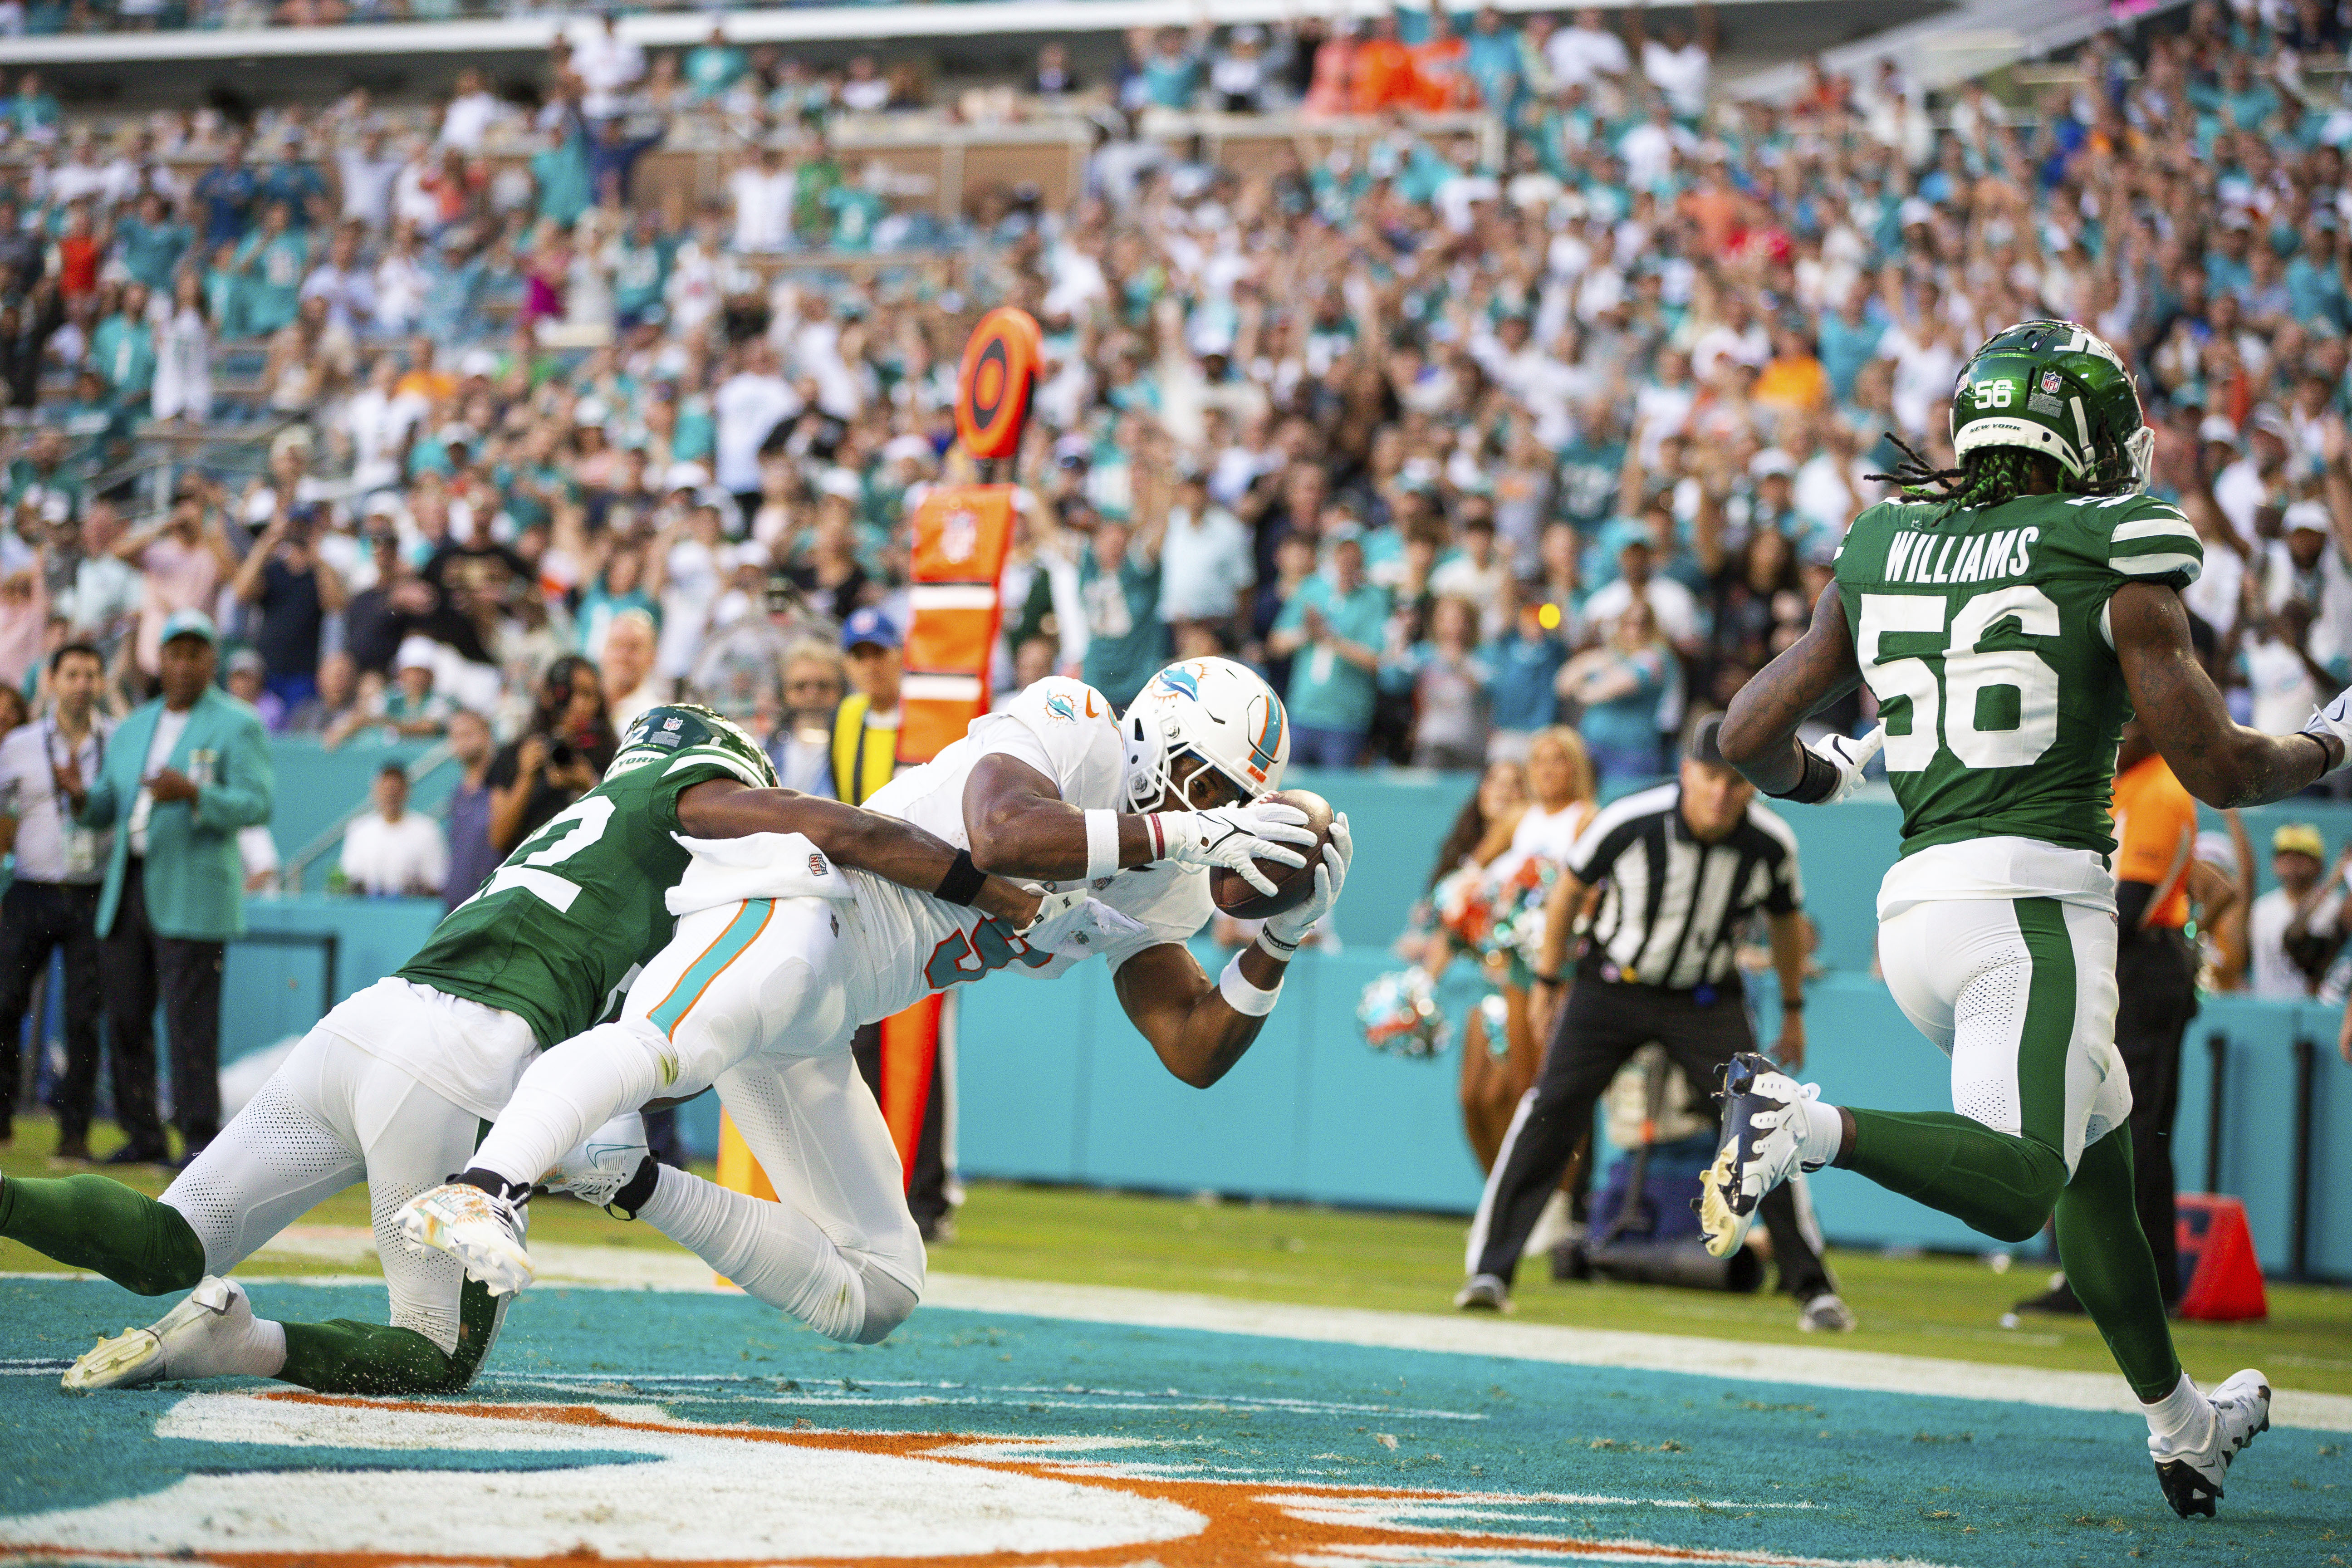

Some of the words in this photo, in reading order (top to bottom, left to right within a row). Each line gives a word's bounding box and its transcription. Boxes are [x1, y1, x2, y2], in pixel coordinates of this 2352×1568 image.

[1975, 379, 2013, 410] 56
[2044, 379, 2057, 390] NFL
[1970, 424, 1990, 433] NEW
[1885, 526, 2039, 584] WILLIAMS
[1857, 585, 2060, 772] 56
[811, 857, 821, 874] NFL
